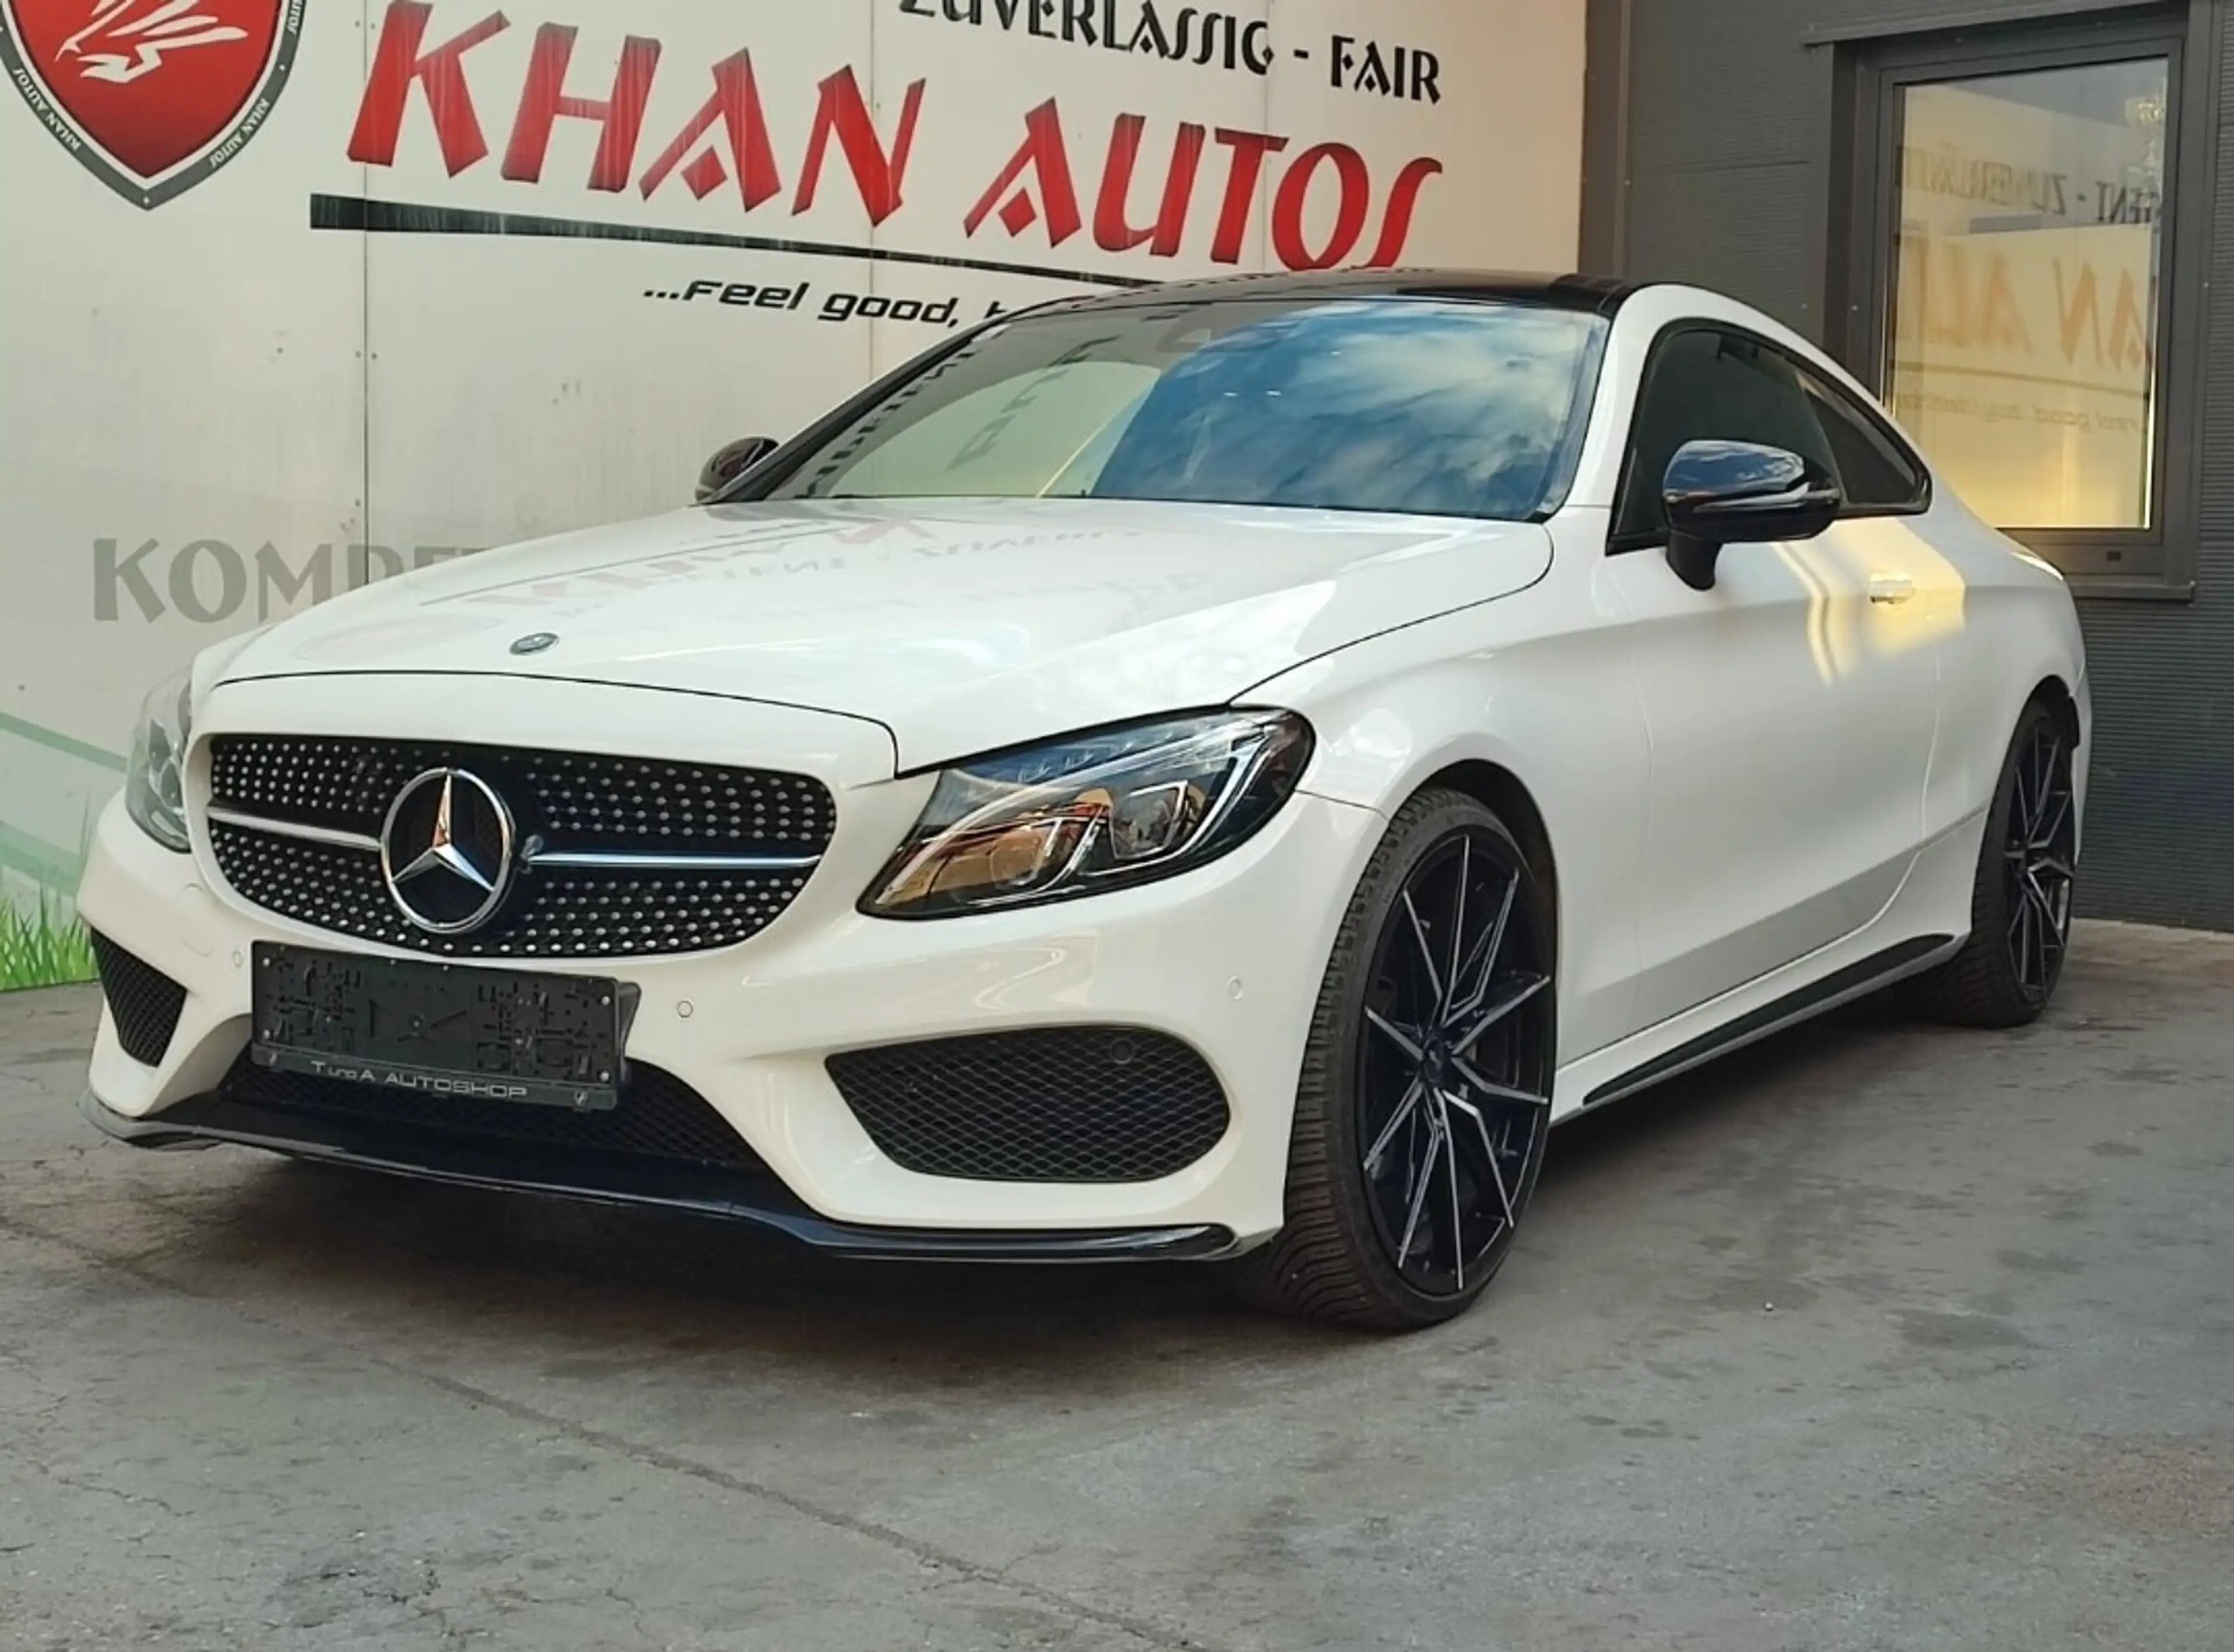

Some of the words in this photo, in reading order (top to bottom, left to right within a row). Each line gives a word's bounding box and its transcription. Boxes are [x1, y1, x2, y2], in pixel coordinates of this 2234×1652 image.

[12, 67, 49, 111] AUTOS
[1331, 35, 1440, 105] FAIR
[347, 1, 926, 227] KHAN
[963, 97, 1442, 270] AUTOS
[644, 280, 809, 310] ...Feel
[817, 293, 958, 327] good,
[94, 538, 490, 624] KOMP
[385, 1072, 528, 1099] AUTOSHOP
